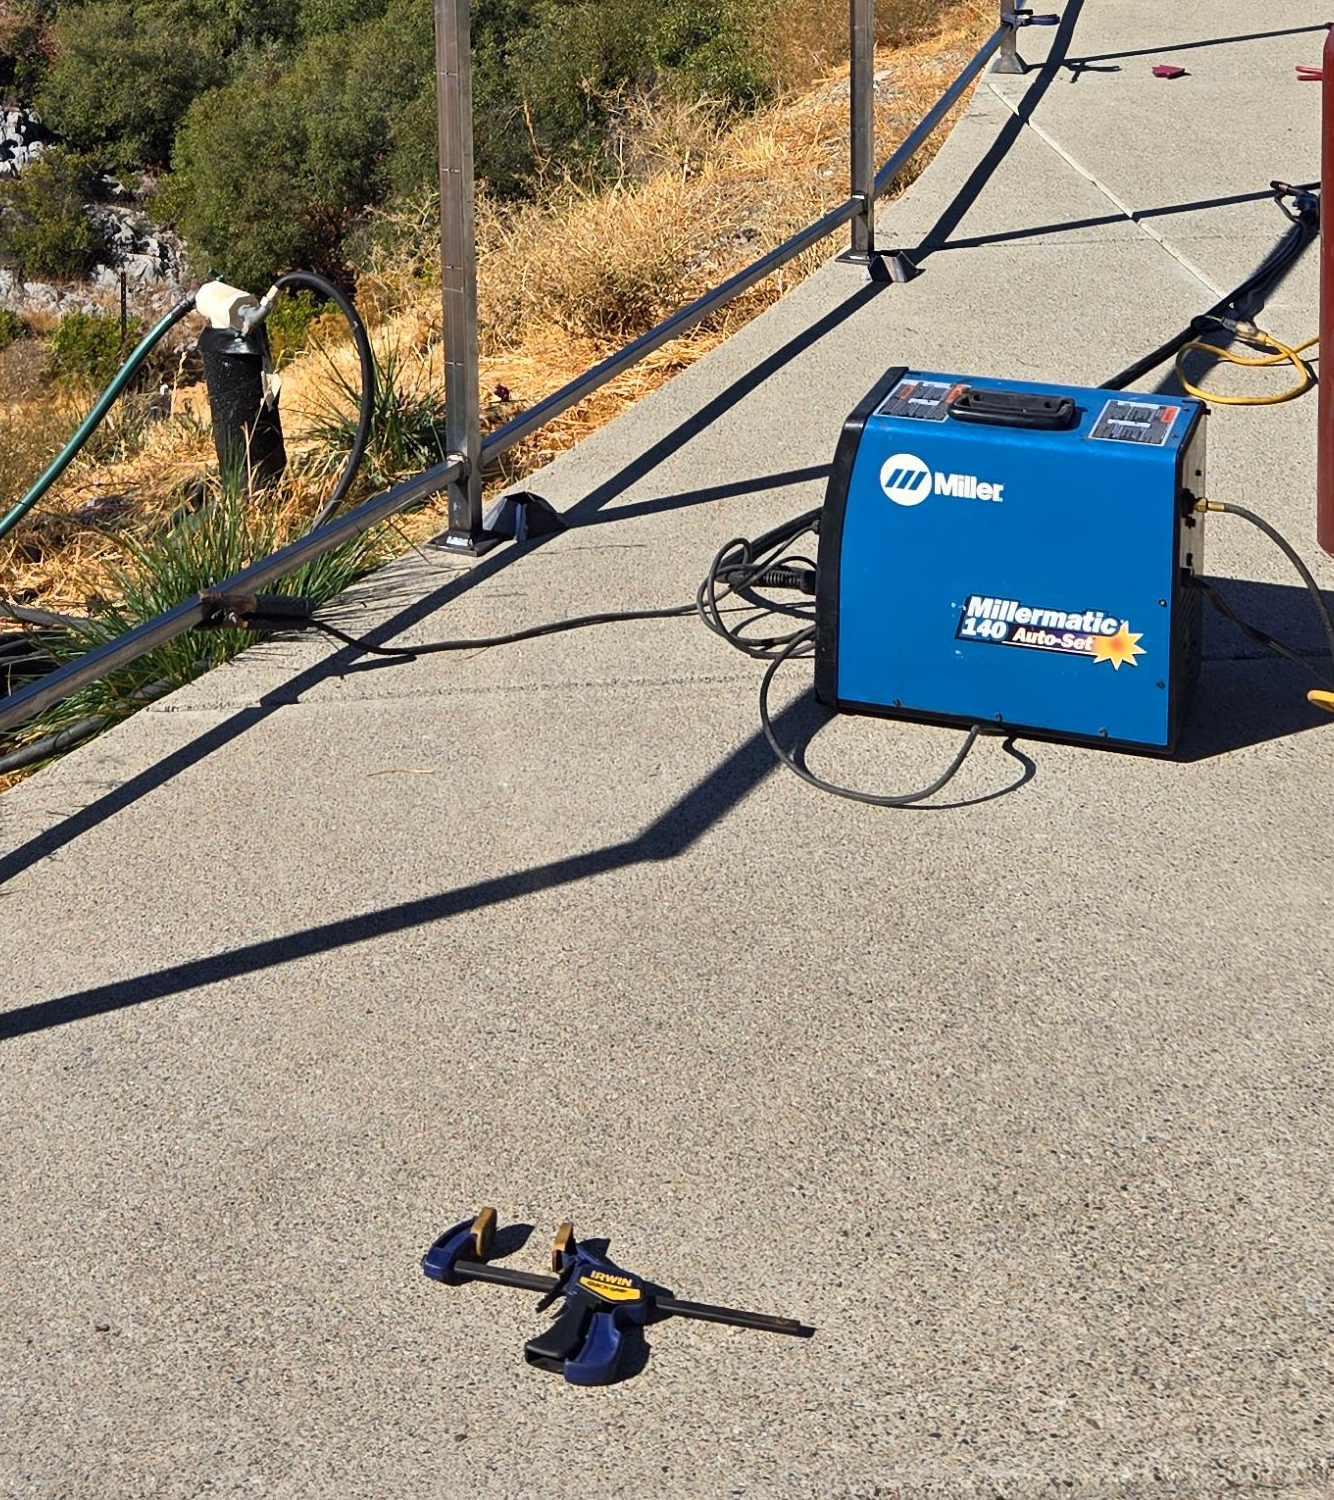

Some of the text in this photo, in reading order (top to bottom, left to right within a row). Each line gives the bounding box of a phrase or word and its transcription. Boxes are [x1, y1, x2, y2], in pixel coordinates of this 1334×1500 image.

[934, 471, 1004, 502] Miller
[967, 595, 1118, 635] Millermatic
[961, 617, 1094, 651] 140 Auto-Set
[590, 1270, 633, 1287] IRWIN
